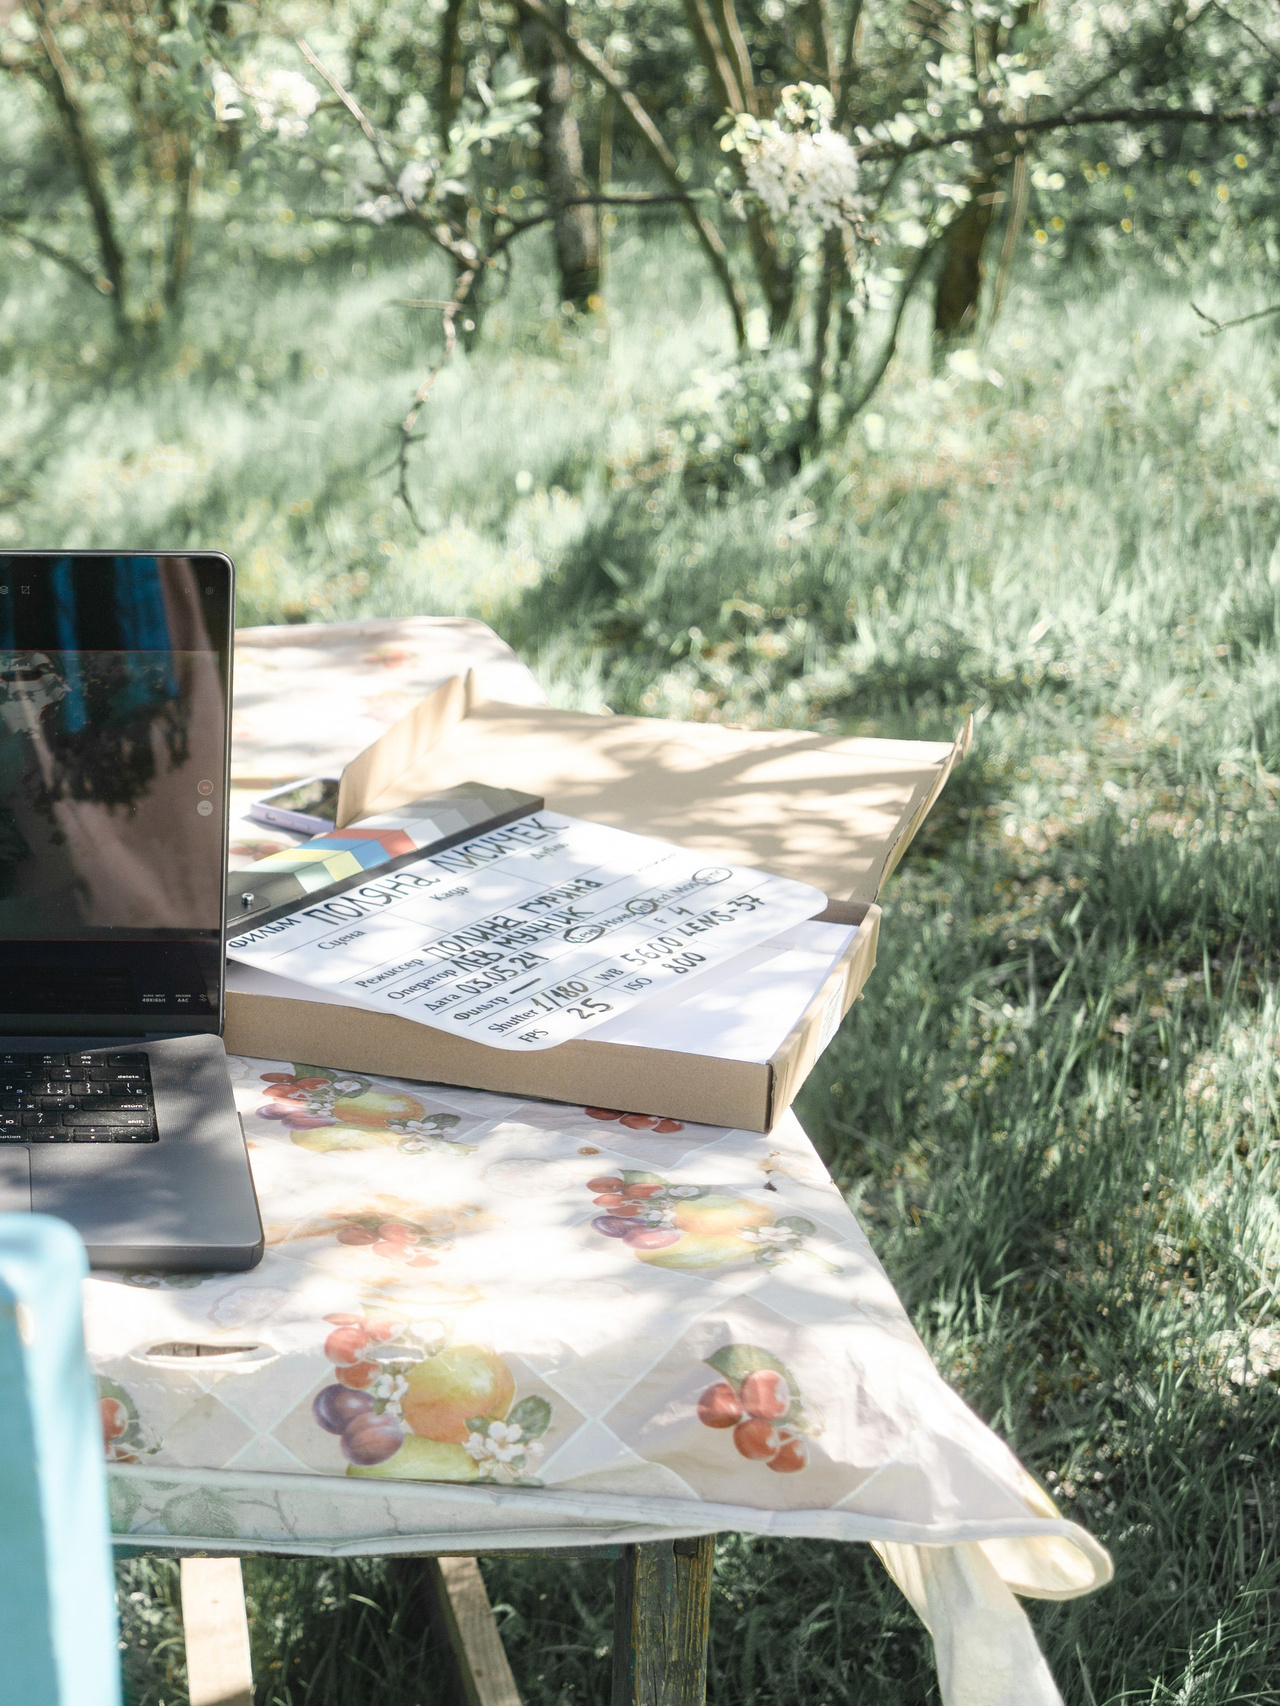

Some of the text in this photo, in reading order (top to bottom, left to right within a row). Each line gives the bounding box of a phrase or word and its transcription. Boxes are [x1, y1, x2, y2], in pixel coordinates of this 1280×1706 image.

[427, 817, 570, 874] ЛИСИЧЕК
[429, 885, 470, 902] Кадр
[653, 917, 668, 925] F
[667, 906, 696, 916] 4
[676, 894, 766, 937] LENS-37
[317, 929, 367, 950] Сцена
[450, 905, 595, 973] ЛЕВ МУЧНИК
[619, 936, 684, 967] 5600
[661, 951, 707, 975] 800
[354, 958, 425, 988] Режиссер
[387, 968, 458, 1000] Оператор
[455, 951, 550, 995] 03.05.24
[594, 968, 624, 981] WB
[623, 976, 653, 991] ISO
[424, 993, 462, 1012] Дата
[453, 995, 510, 1021] Фильтр
[530, 981, 589, 1012] 1/180
[566, 997, 614, 1020] 25
[488, 1009, 539, 1033] Shutter
[518, 1028, 549, 1043] FPS
